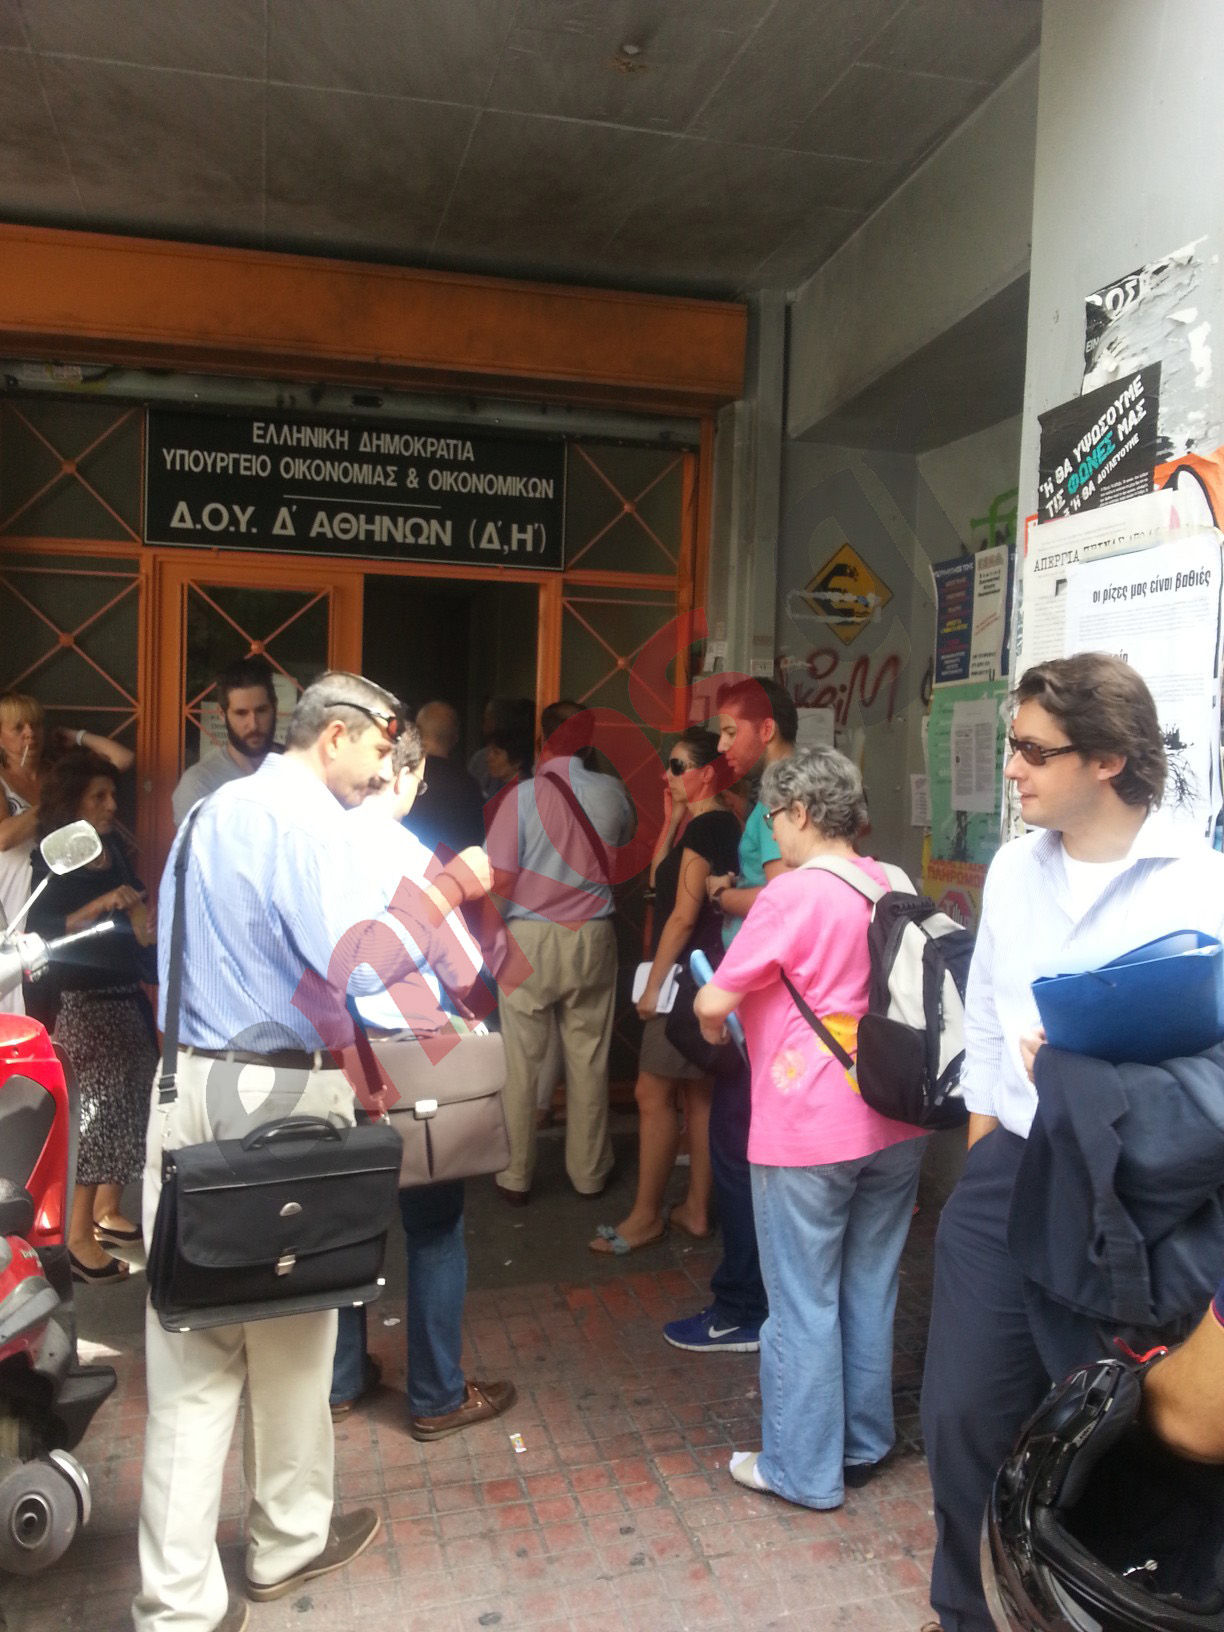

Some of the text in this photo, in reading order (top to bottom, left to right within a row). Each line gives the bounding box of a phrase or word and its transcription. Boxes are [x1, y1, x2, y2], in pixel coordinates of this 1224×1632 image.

[252, 422, 475, 461] ΕΛΛΗΝΙΚΗ ΔΗΜΟΚΡΑΤΙΑ
[1055, 458, 1073, 484] ΘΑ
[1073, 374, 1144, 463] ΥΨΩΣΟΥΜΕ
[162, 448, 554, 499] ΥΠΟΥΡΓΕΙΟ ΟΙΚΟΝΟΜΙΑΣ & ΟΙΚΟΝΟΜΙΚΩΝ
[1045, 488, 1066, 518] ΤΙΣ
[1067, 430, 1116, 494] ΦΩΝΕΣ
[1117, 398, 1147, 441] ΜΑΣ
[1082, 480, 1096, 500] ΘΑ
[1097, 433, 1140, 484] ΔΟΥΛΕΥΟΥΜΕ
[169, 500, 258, 534] Δ.Ο.Υ.
[309, 511, 452, 547] ΑΘΗΝΩΝ
[1034, 549, 1080, 572] ΑΠΕΡΓΙΑ
[1092, 566, 1211, 604] οι ρίζες μας είναι βαθιές
